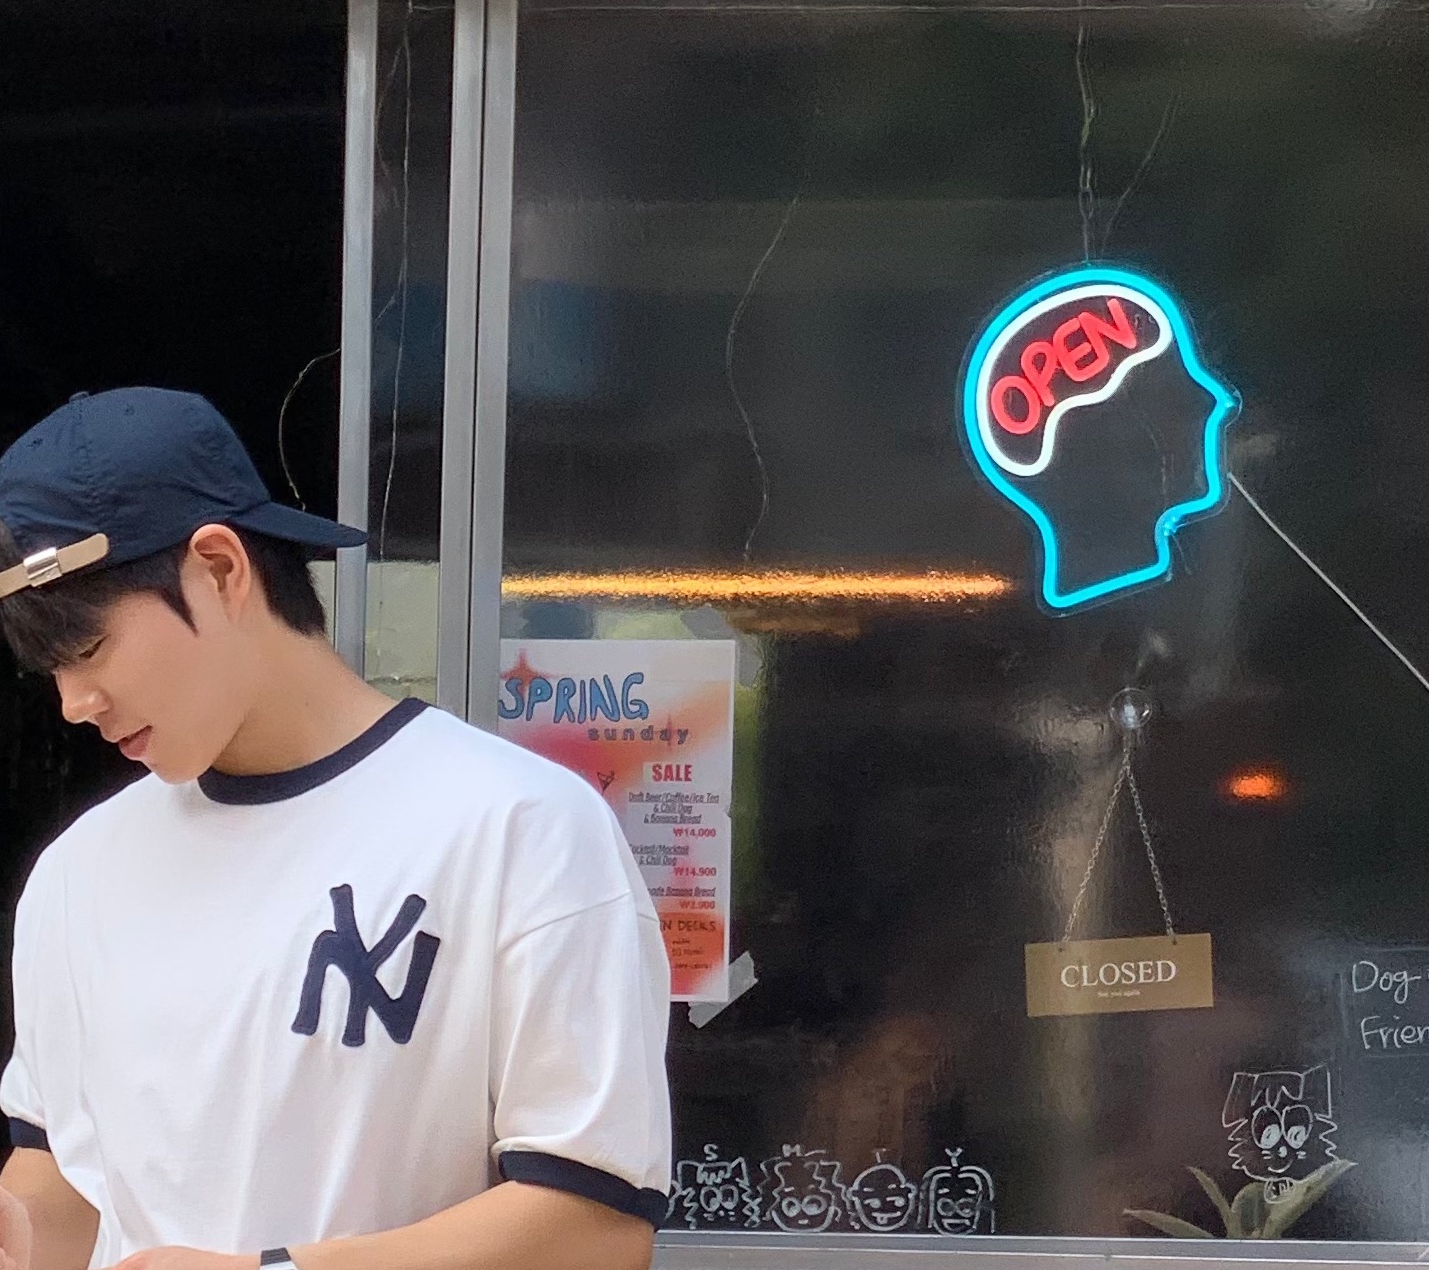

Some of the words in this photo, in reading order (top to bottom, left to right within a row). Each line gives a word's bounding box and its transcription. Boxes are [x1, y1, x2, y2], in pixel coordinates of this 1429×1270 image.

[991, 298, 1137, 434] OPEN
[498, 672, 649, 723] SPRING
[587, 724, 688, 745] sunday
[651, 763, 693, 783] SALE
[678, 920, 717, 932] DECKS
[291, 883, 441, 1047] NY
[1060, 960, 1177, 988] CLOSED
